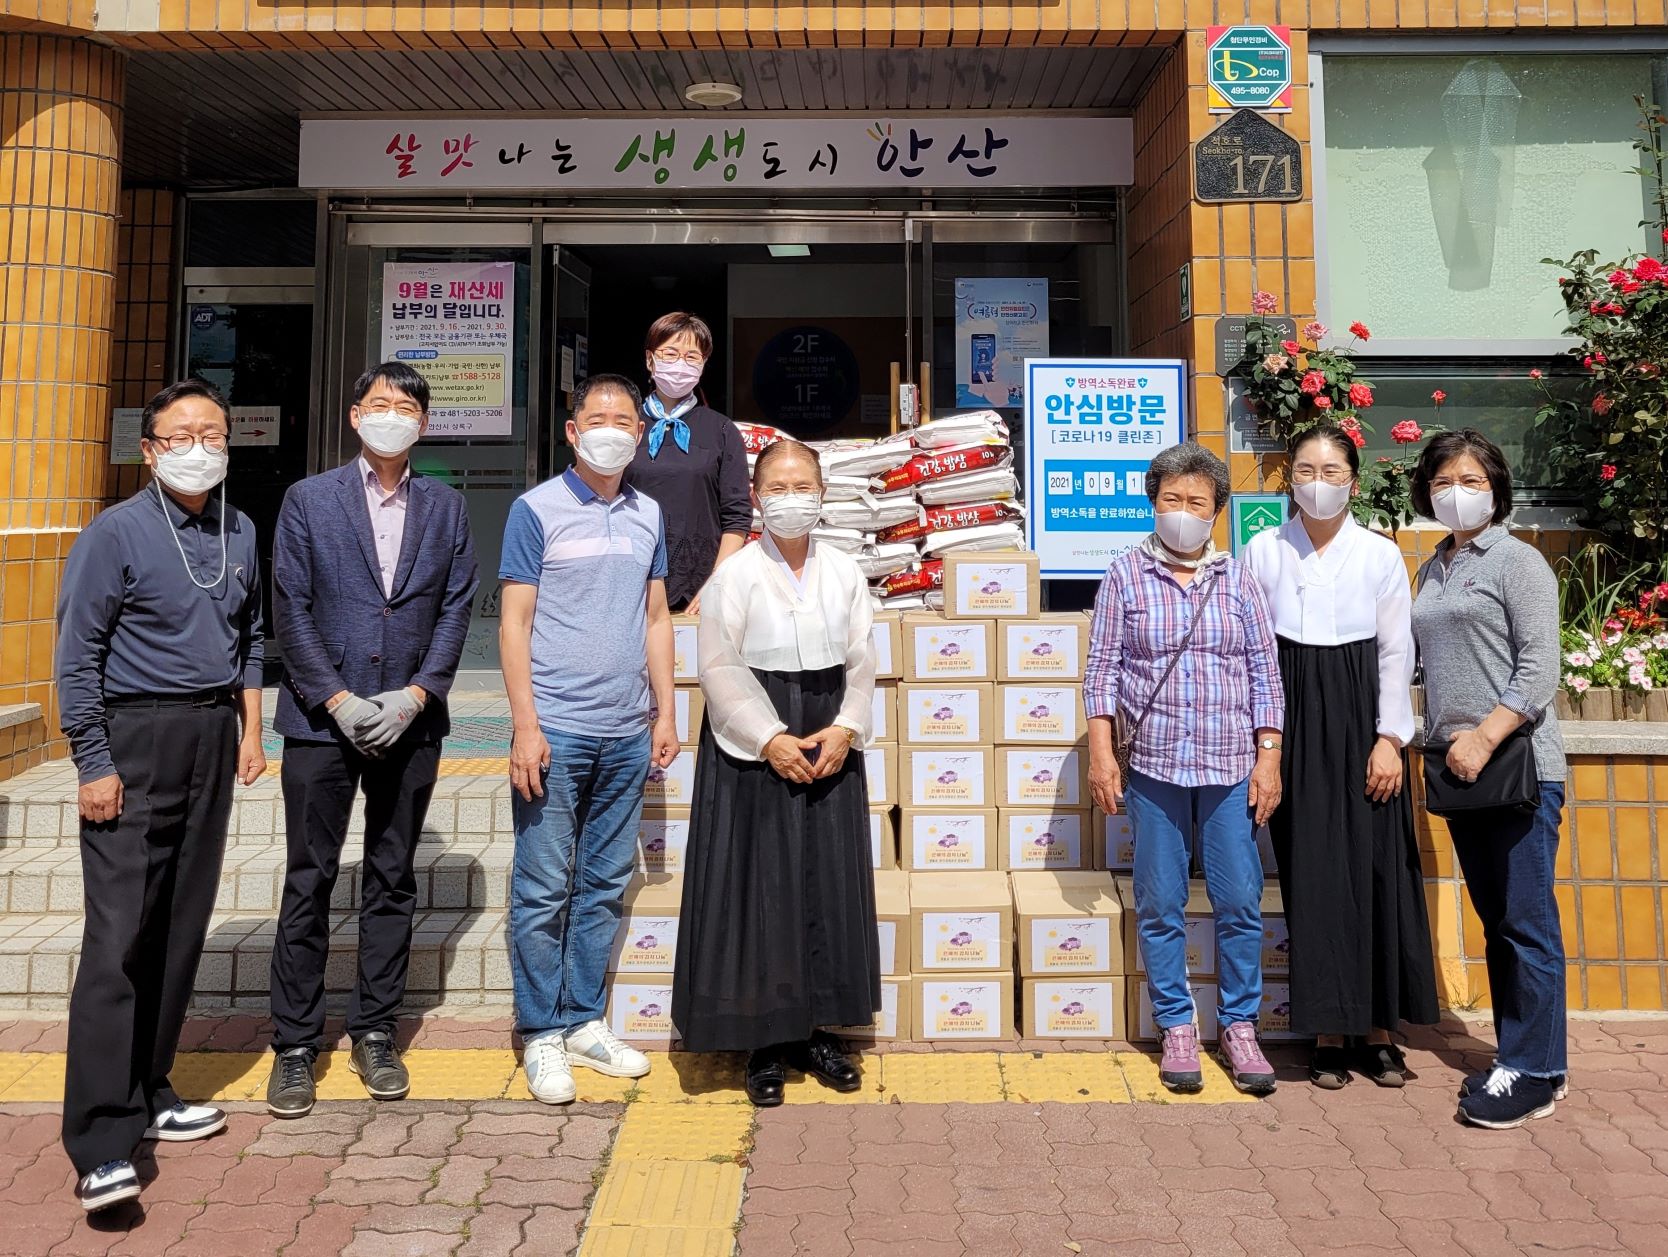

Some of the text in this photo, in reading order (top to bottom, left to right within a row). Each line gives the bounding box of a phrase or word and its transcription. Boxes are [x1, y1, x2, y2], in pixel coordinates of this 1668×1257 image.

[1259, 67, 1280, 78] Cop
[1230, 86, 1270, 95] 495-8080
[1211, 135, 1244, 146] 석호로
[1202, 146, 1243, 155] Seokho-ro
[1229, 153, 1297, 195] 171
[398, 281, 504, 300] 9월은 재산세
[392, 302, 505, 319] 납부의 달입니다.
[194, 312, 213, 323] ADT
[793, 334, 820, 353] 2F
[459, 372, 501, 380] 1588-5128
[1077, 377, 1136, 389] 방역소독완료
[795, 384, 819, 403] 1F
[1045, 394, 1166, 425] 안심방문
[1050, 477, 1070, 488] 2021
[1051, 507, 1154, 519] 방역소독을 완료하였습니
